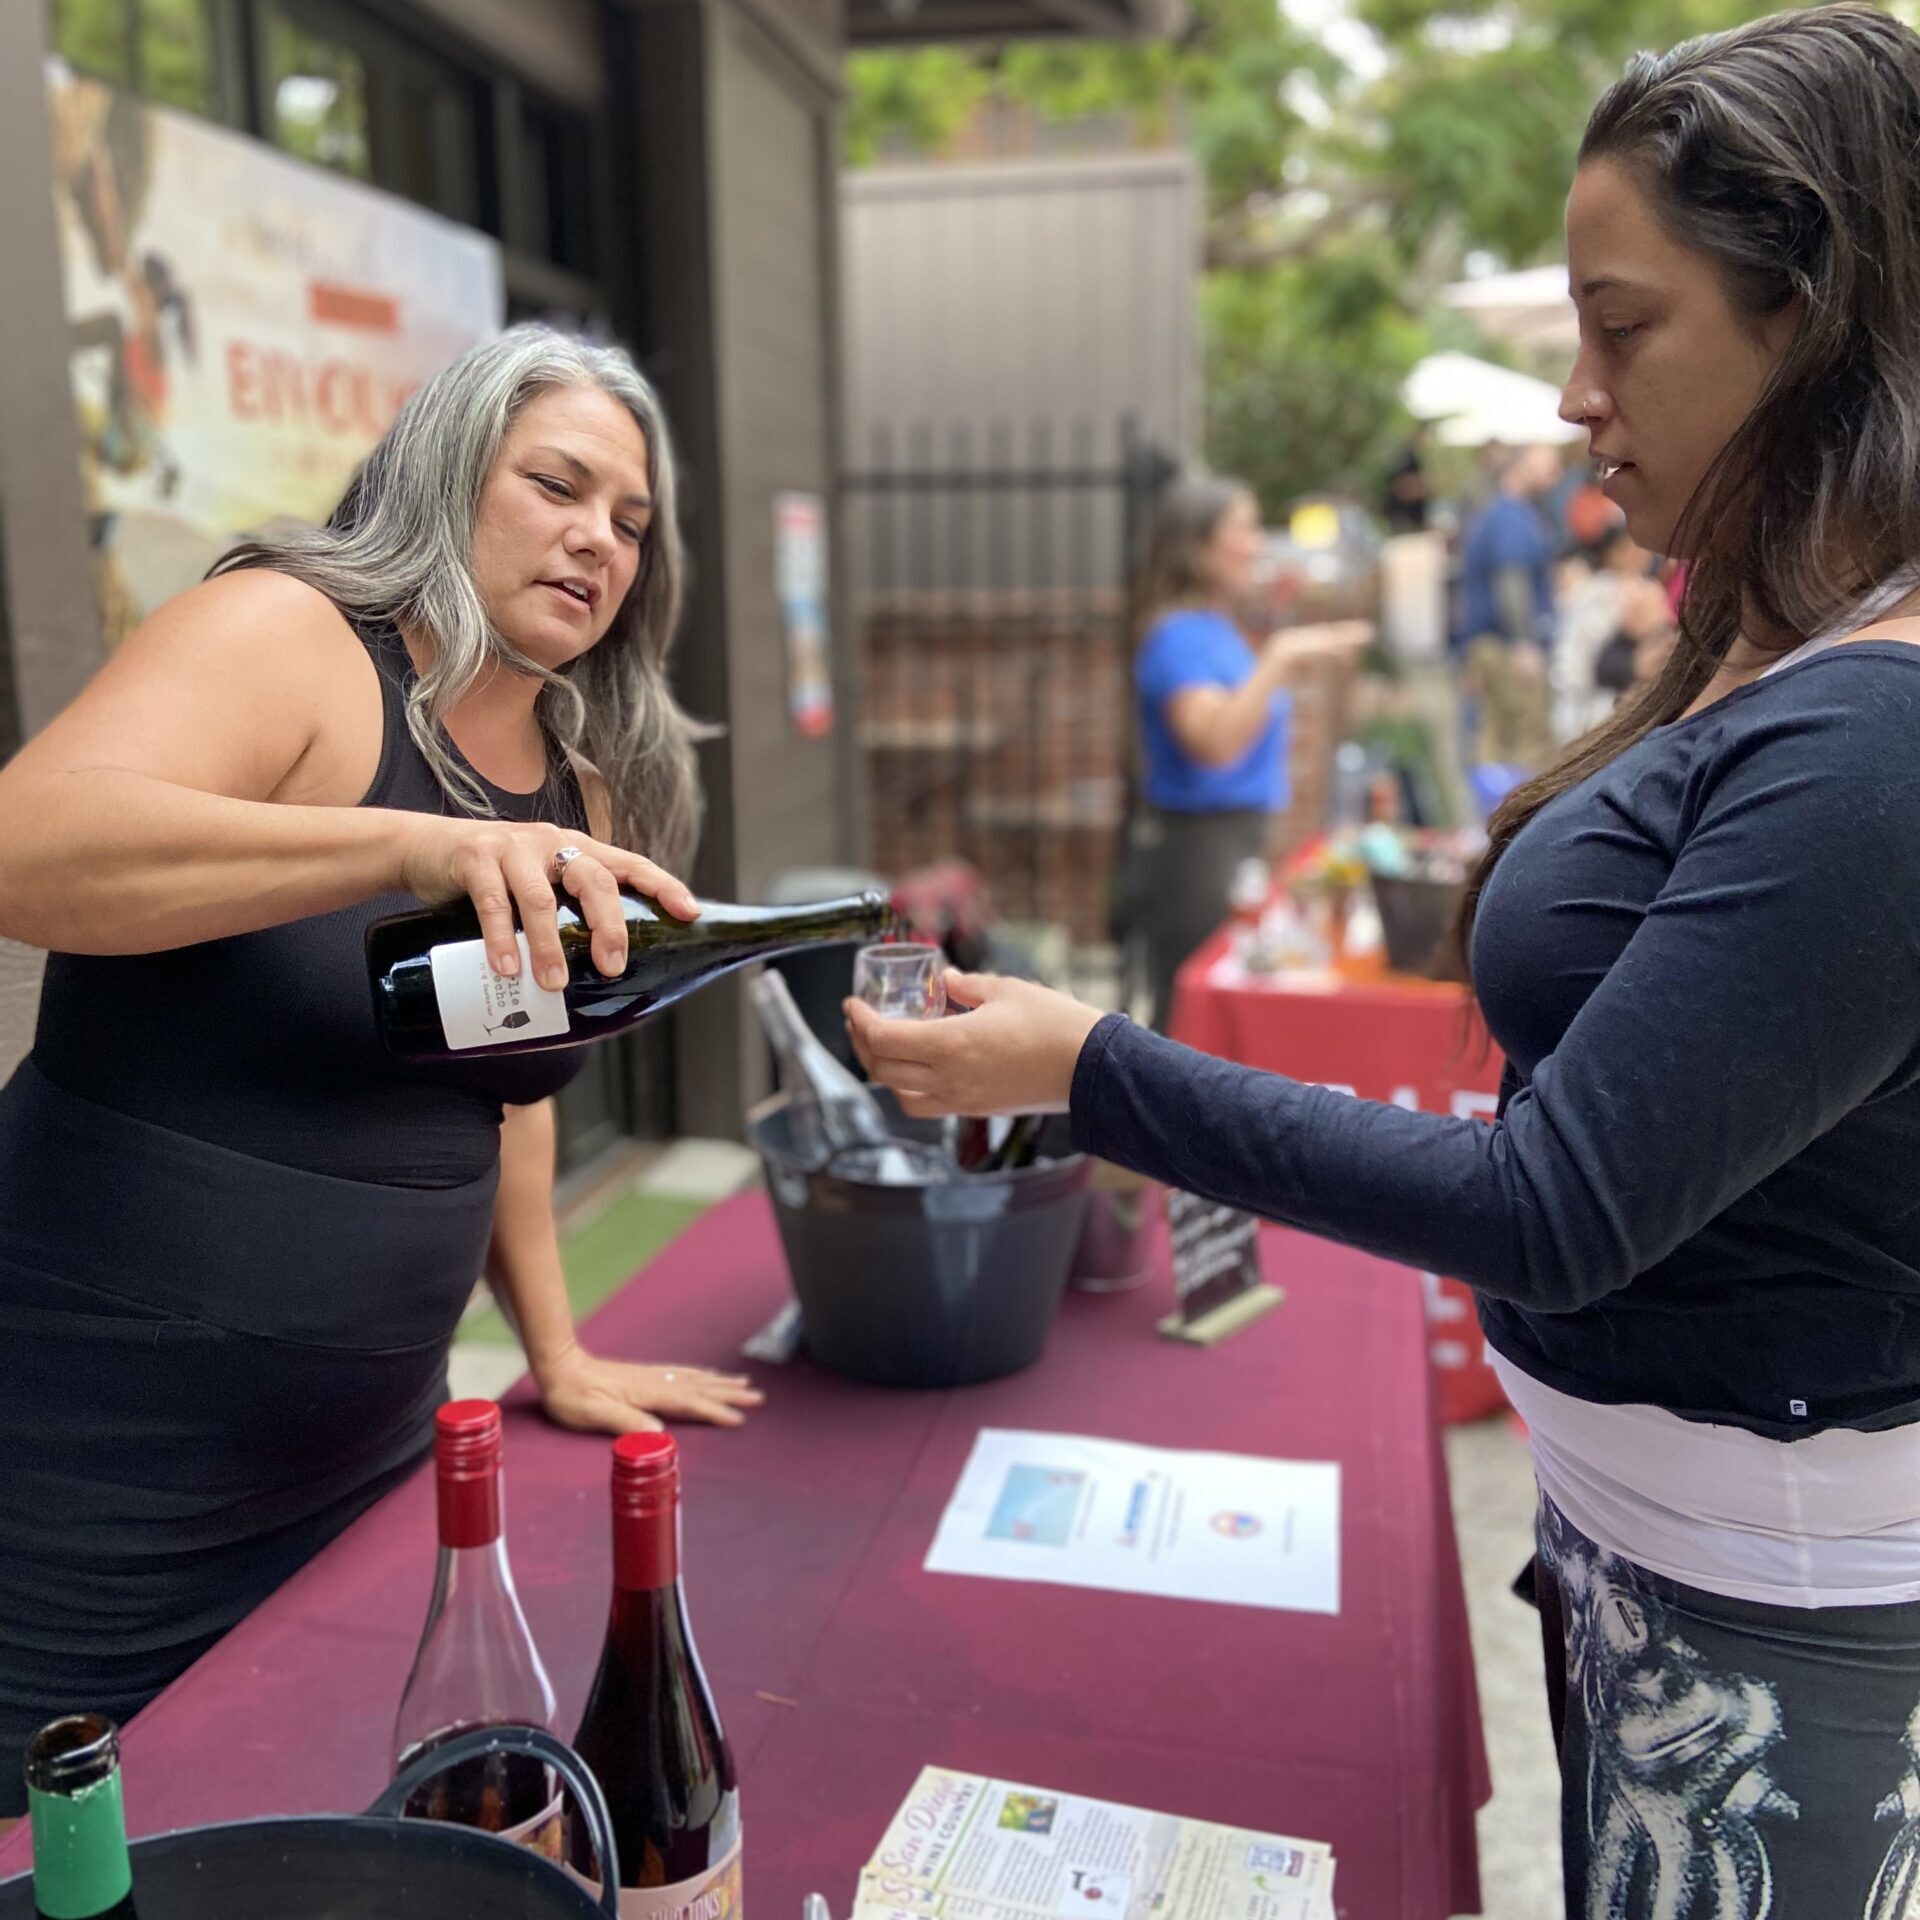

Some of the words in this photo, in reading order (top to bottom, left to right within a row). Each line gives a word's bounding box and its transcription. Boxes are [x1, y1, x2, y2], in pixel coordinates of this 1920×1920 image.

[493, 975, 507, 1008] echo
[921, 1841, 947, 1877] WINE
[936, 1782, 977, 1841] COUNTRY
[881, 1838, 922, 1878] San
